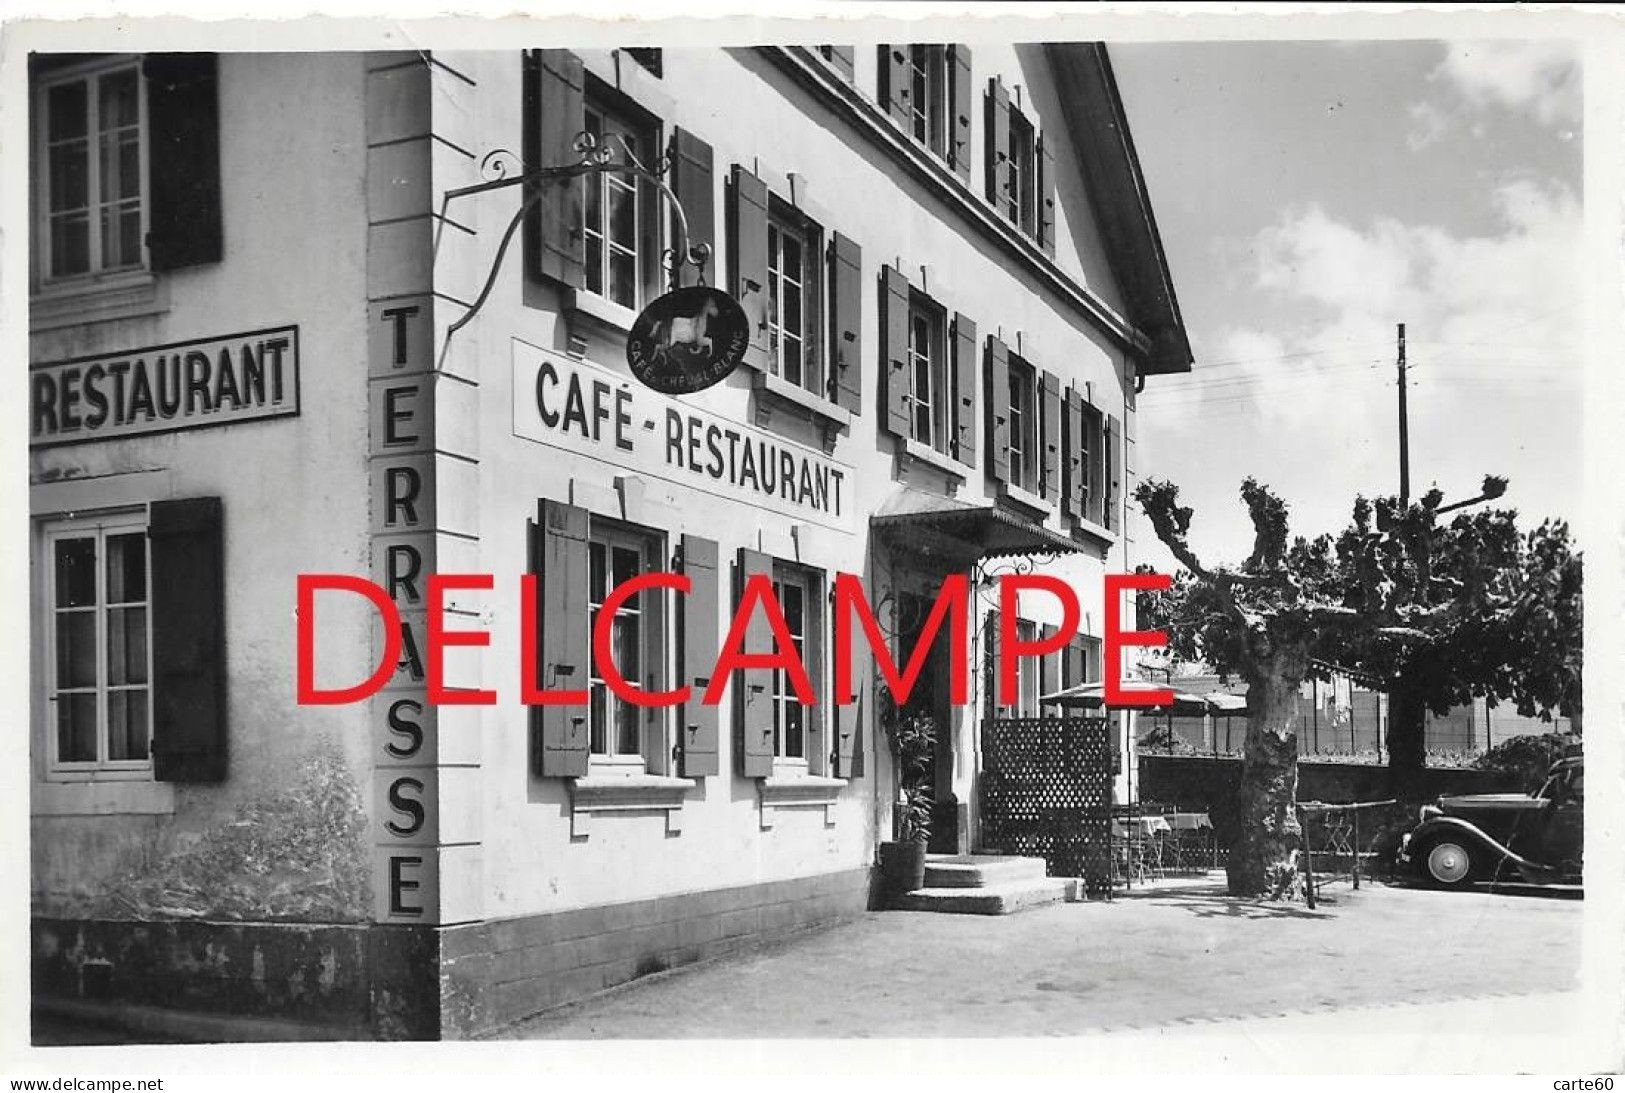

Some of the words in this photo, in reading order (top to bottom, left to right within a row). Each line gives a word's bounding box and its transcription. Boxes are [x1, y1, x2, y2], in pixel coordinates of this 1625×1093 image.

[32, 338, 290, 437] RESTAURANT
[536, 361, 633, 451] CAFÉ
[666, 407, 844, 517] RESTAURANT
[382, 306, 426, 914] TERRASSE
